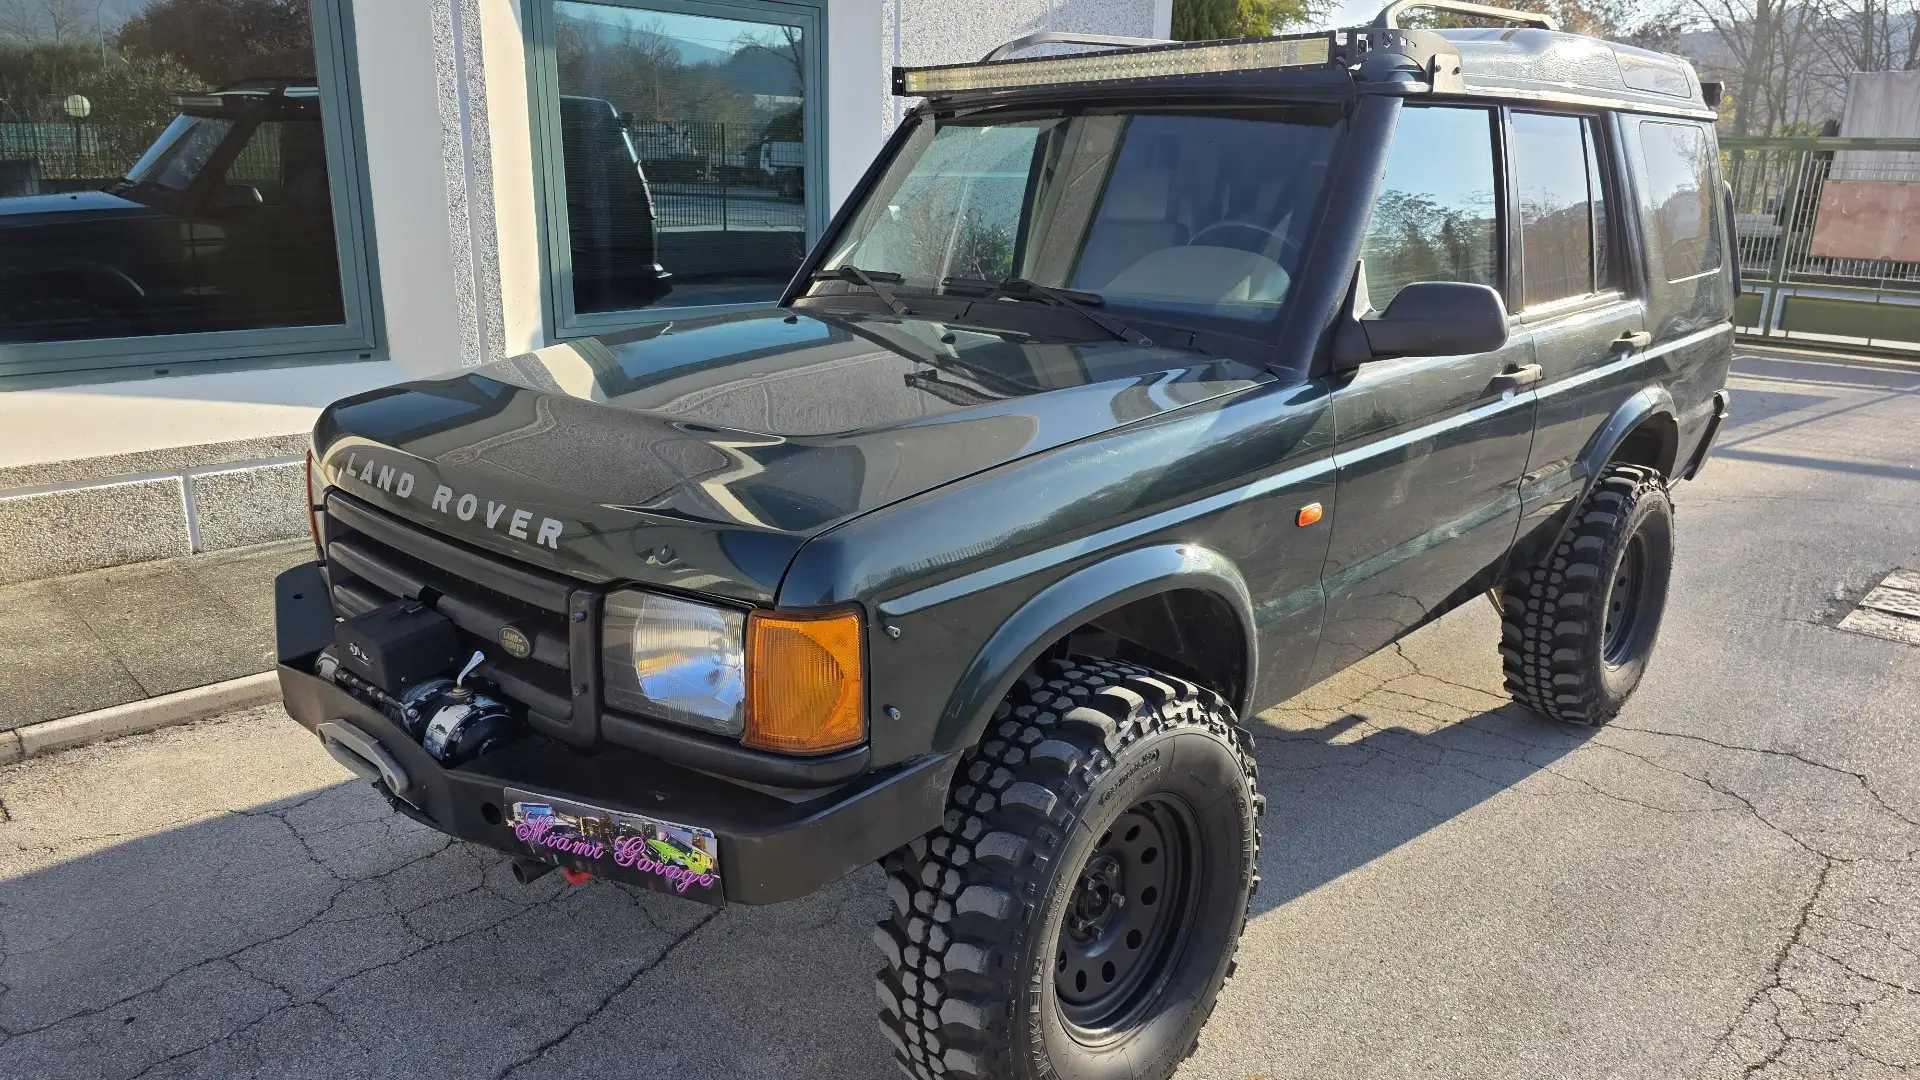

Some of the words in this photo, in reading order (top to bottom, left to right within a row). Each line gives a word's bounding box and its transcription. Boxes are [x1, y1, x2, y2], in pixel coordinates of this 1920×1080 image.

[345, 452, 415, 499] LAND
[431, 485, 564, 550] ROVER
[503, 630, 519, 643] LAND
[515, 810, 605, 860] Miami
[613, 835, 722, 893] Garage
